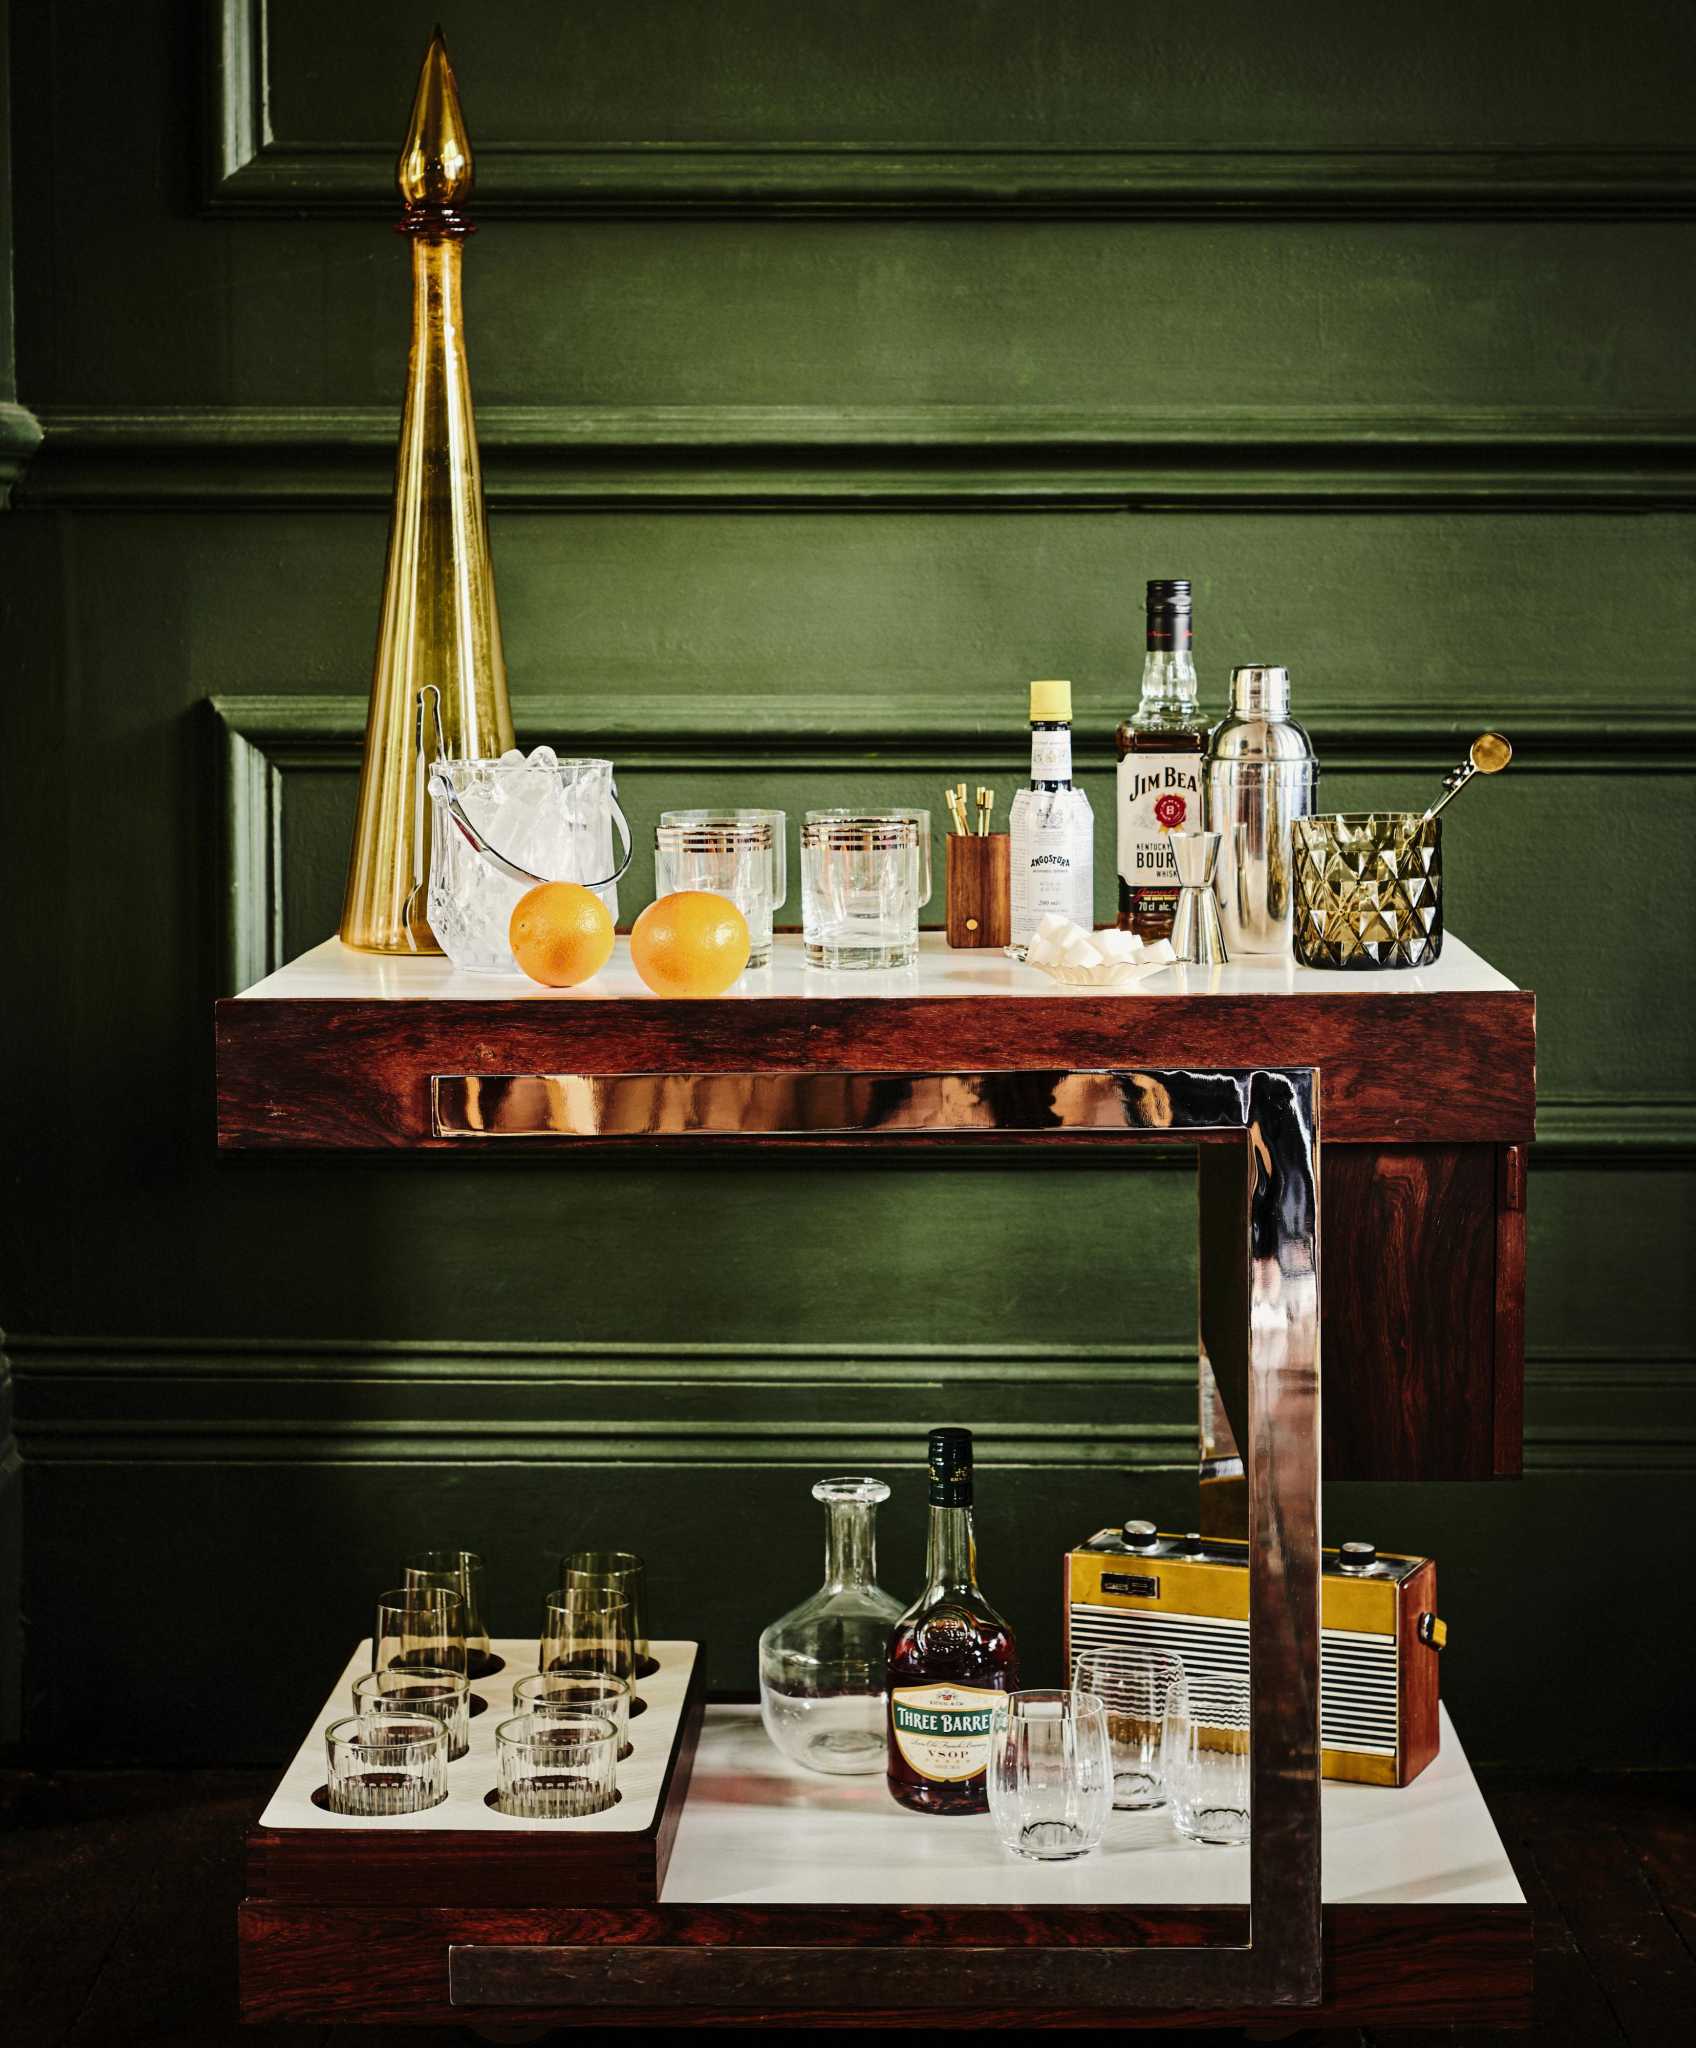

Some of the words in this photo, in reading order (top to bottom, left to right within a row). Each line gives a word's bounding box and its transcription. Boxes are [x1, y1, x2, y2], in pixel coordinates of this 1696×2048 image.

[1129, 773, 1160, 802] JIM
[1165, 766, 1200, 792] BEA
[1136, 852, 1175, 868] BOUR
[896, 1706, 938, 1730] THREE
[940, 1714, 993, 1733] BARRE
